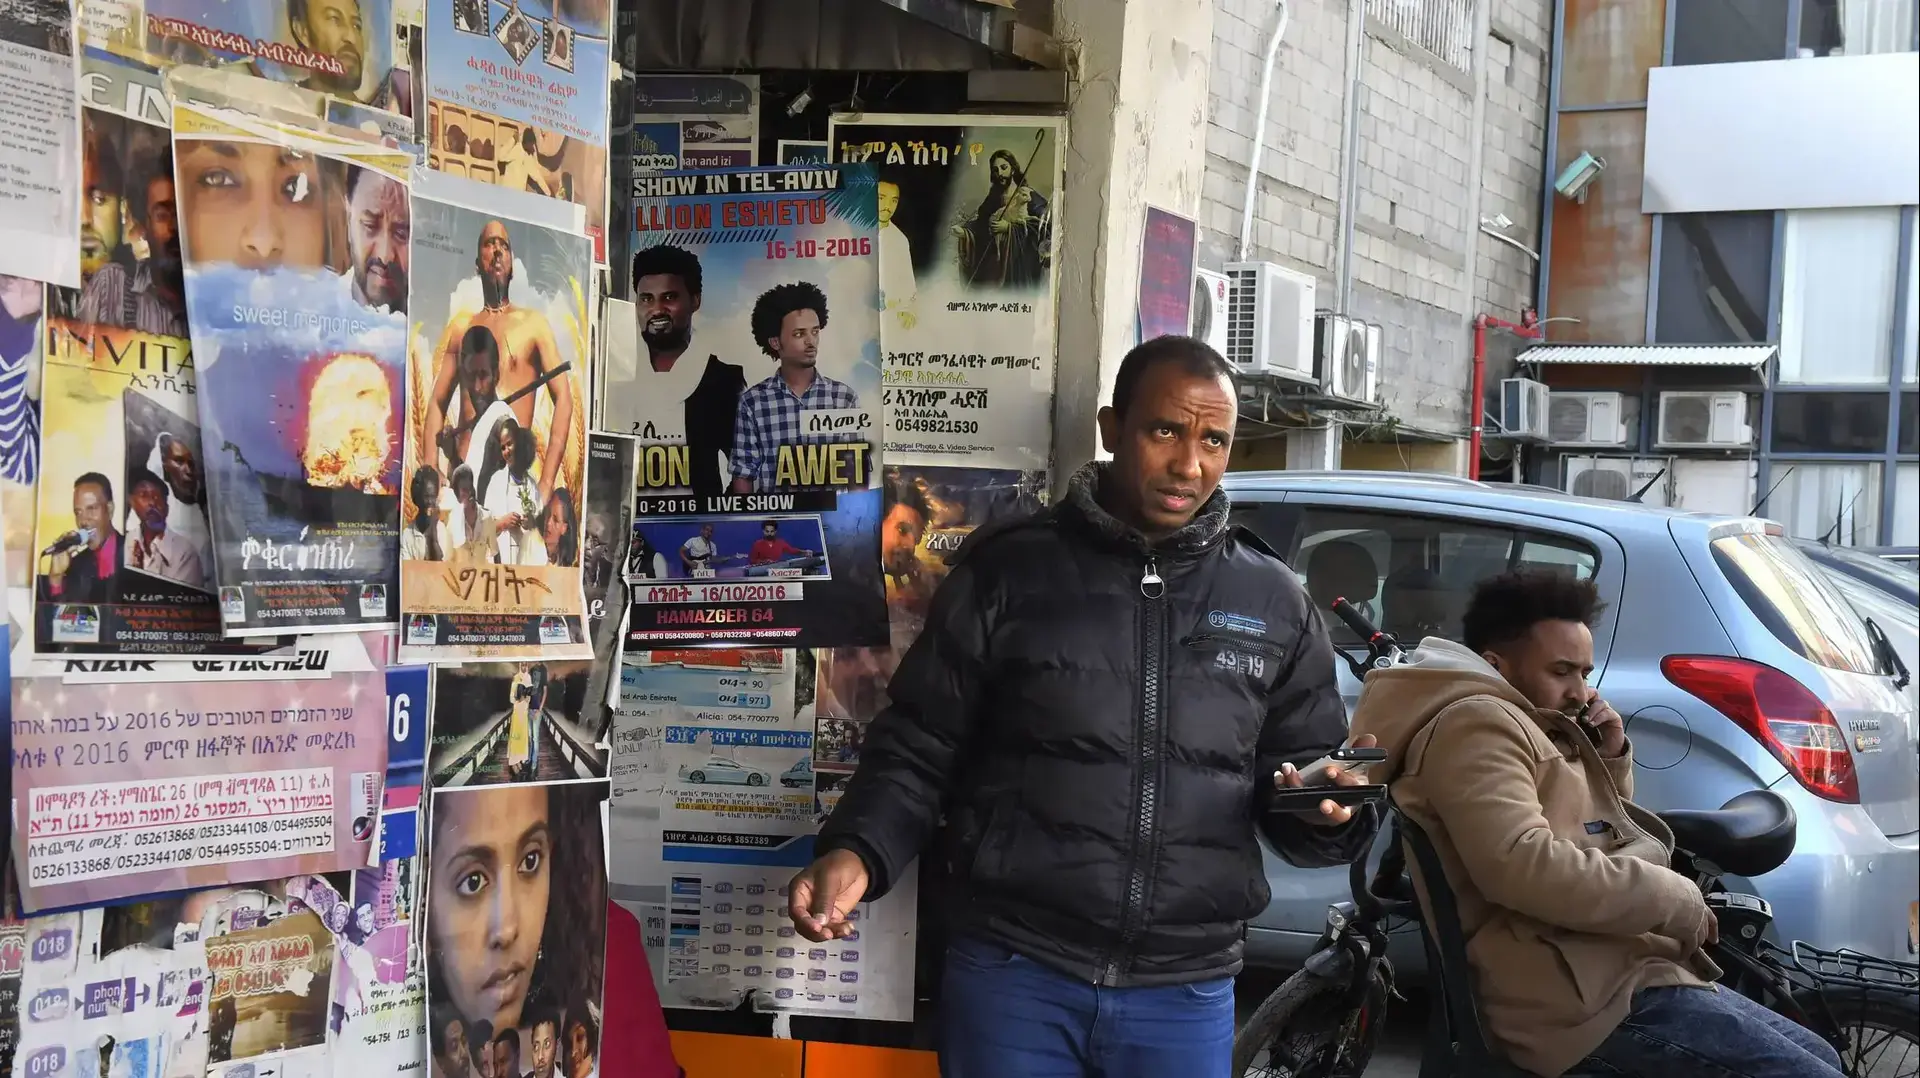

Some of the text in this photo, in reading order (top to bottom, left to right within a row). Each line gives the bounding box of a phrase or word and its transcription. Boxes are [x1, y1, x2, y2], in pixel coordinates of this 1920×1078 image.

[700, 156, 718, 166] and
[721, 156, 732, 166] izi
[633, 169, 839, 197] SHOW IN TEL-AVIV
[631, 199, 827, 231] LLION ESHETU
[766, 238, 871, 259] 16-10-2016
[233, 305, 367, 335] sweet memories
[895, 419, 978, 434] 0549821530
[776, 443, 870, 486] AWET
[707, 495, 794, 512] LIVE SHOW
[701, 585, 786, 601] 16/10/2016
[257, 609, 272, 618] 054
[305, 608, 318, 616] 054
[656, 608, 773, 625] HAMAZGER 64
[116, 631, 133, 640] 054
[134, 631, 168, 640] 3470075
[172, 632, 188, 640] 054
[1216, 650, 1236, 666] 43
[752, 680, 763, 688] 90
[748, 696, 764, 705] 971
[95, 711, 119, 731] על
[125, 711, 171, 730] 2016
[175, 708, 200, 727] של
[206, 710, 265, 726] הטובים
[271, 708, 327, 723] הזמרים
[331, 707, 353, 721] שני
[697, 712, 780, 723] Alicia: 054-7700779
[51, 717, 90, 733] במה
[16, 731, 355, 769] ለቱ የ 2016 ምርጥ ዘፋኞች በአንድ መድረክ
[170, 784, 186, 801] 26
[281, 775, 303, 792] 11)
[290, 793, 333, 812] במועדון
[95, 810, 134, 828] ומגדל
[184, 803, 200, 819] 26
[38, 936, 66, 952] 018
[32, 1053, 58, 1073] 018
